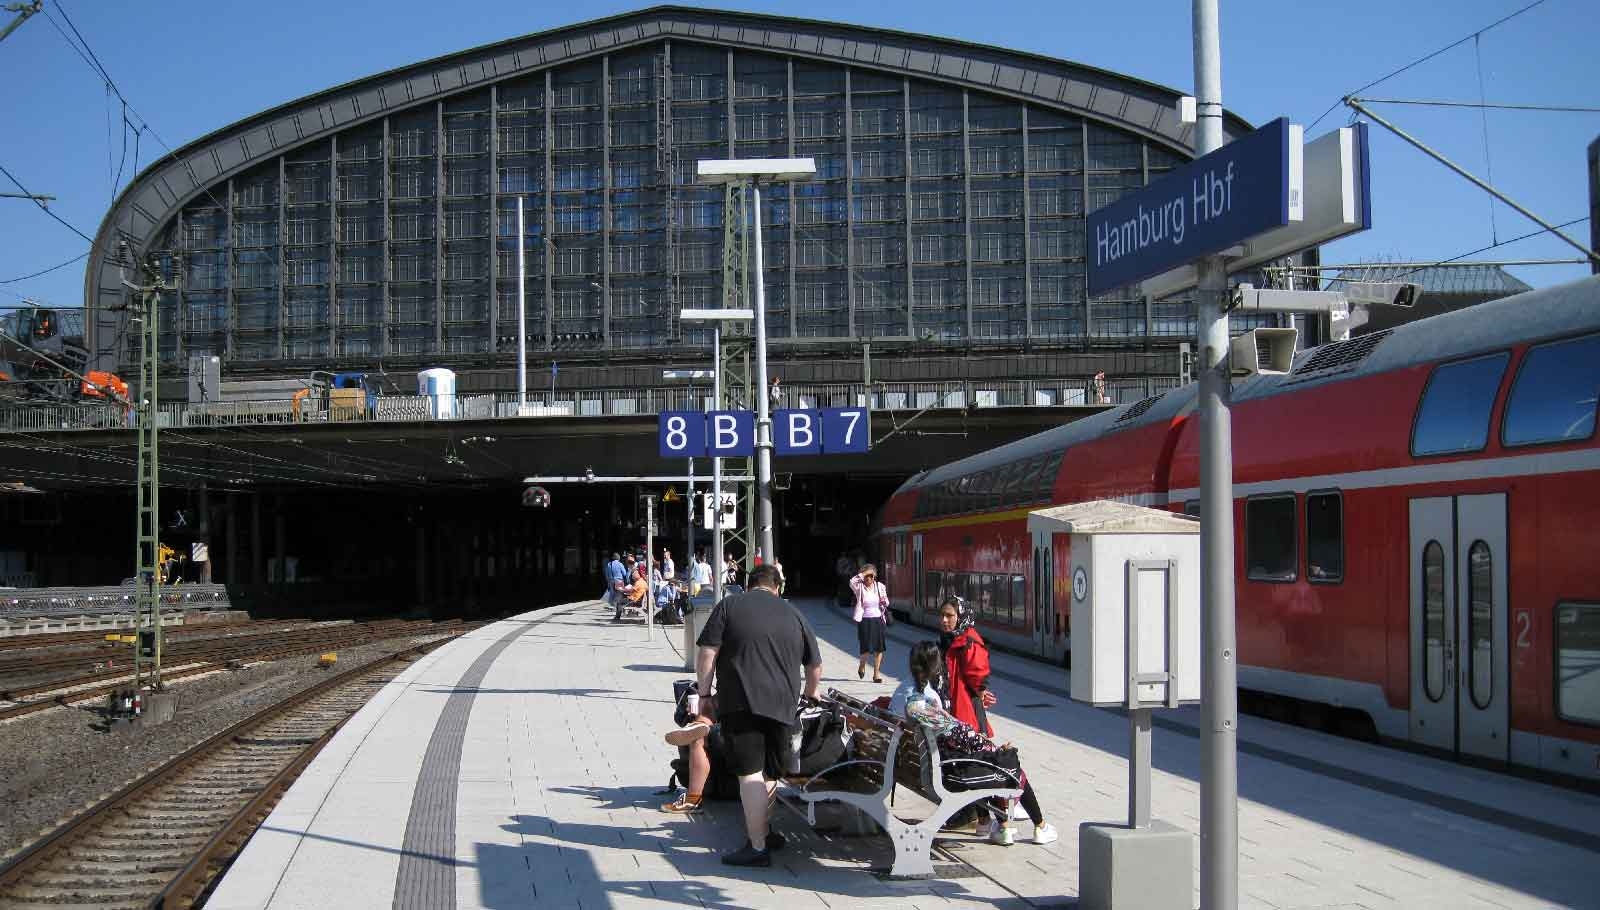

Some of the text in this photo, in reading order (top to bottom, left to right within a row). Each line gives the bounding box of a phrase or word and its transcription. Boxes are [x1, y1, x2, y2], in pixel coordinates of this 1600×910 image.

[1096, 161, 1234, 265] Hamburg Hbf
[666, 415, 739, 450] 8 B
[789, 411, 861, 448] B 7
[1515, 611, 1531, 647] 2
